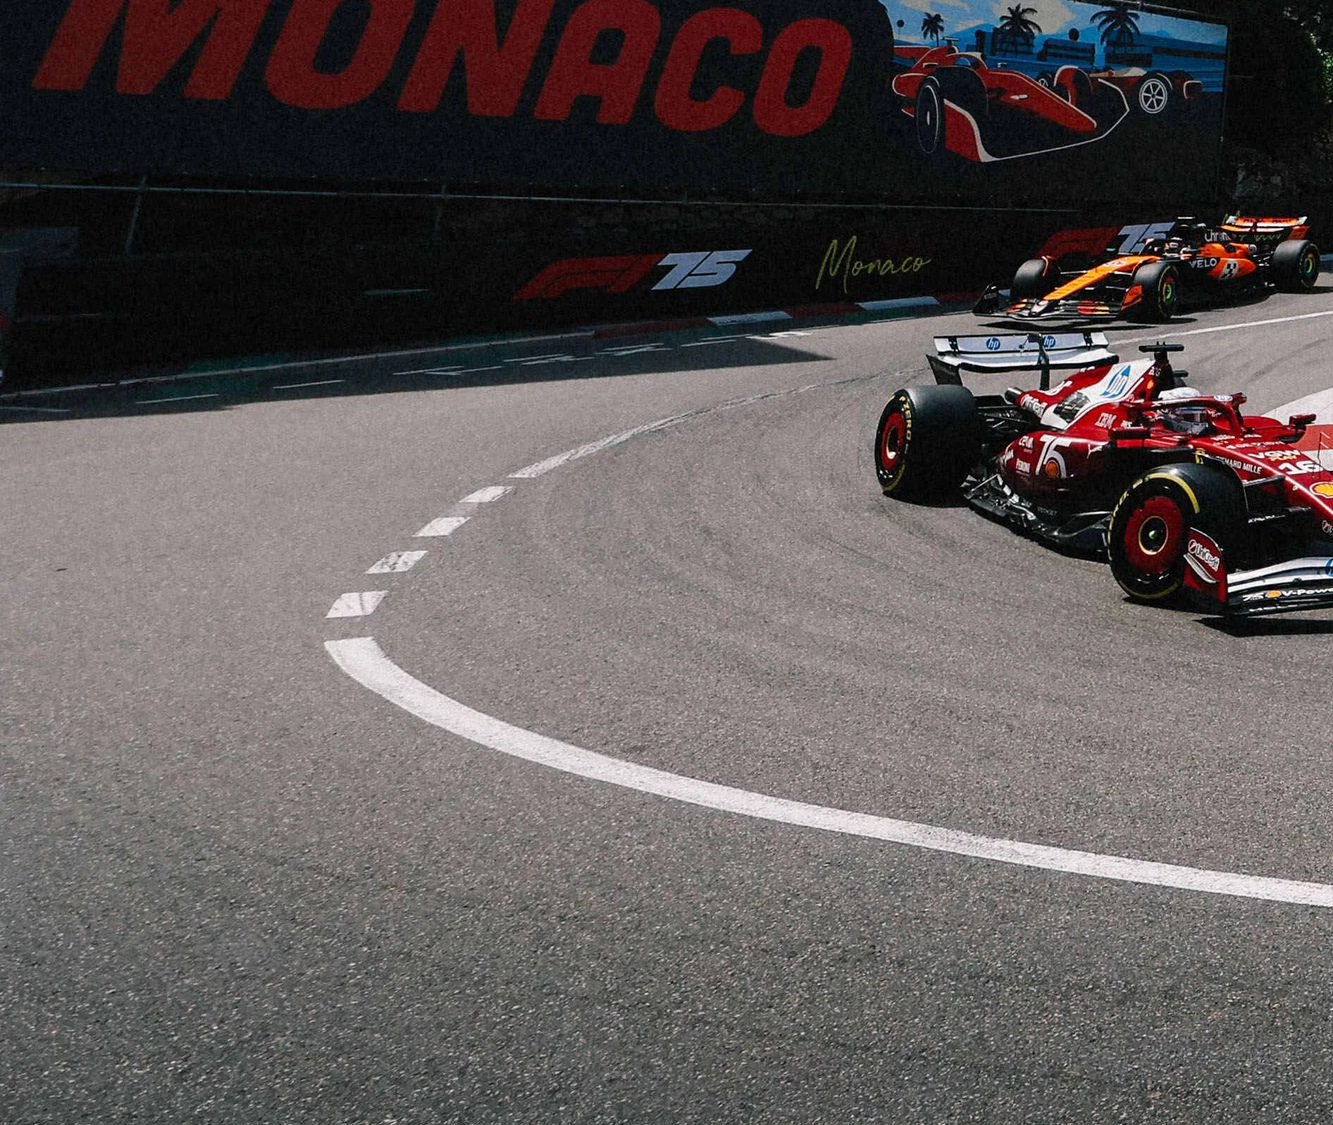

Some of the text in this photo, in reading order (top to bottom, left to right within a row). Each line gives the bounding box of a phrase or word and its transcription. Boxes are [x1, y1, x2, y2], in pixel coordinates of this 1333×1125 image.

[815, 235, 933, 294] Monaco
[1189, 257, 1218, 269] VELO
[512, 249, 753, 299] F1 75
[987, 337, 1000, 351] hp
[1044, 336, 1056, 350] hp
[901, 402, 912, 441] ZERO
[1242, 461, 1263, 475] MILLE
[1278, 460, 1323, 475] 16
